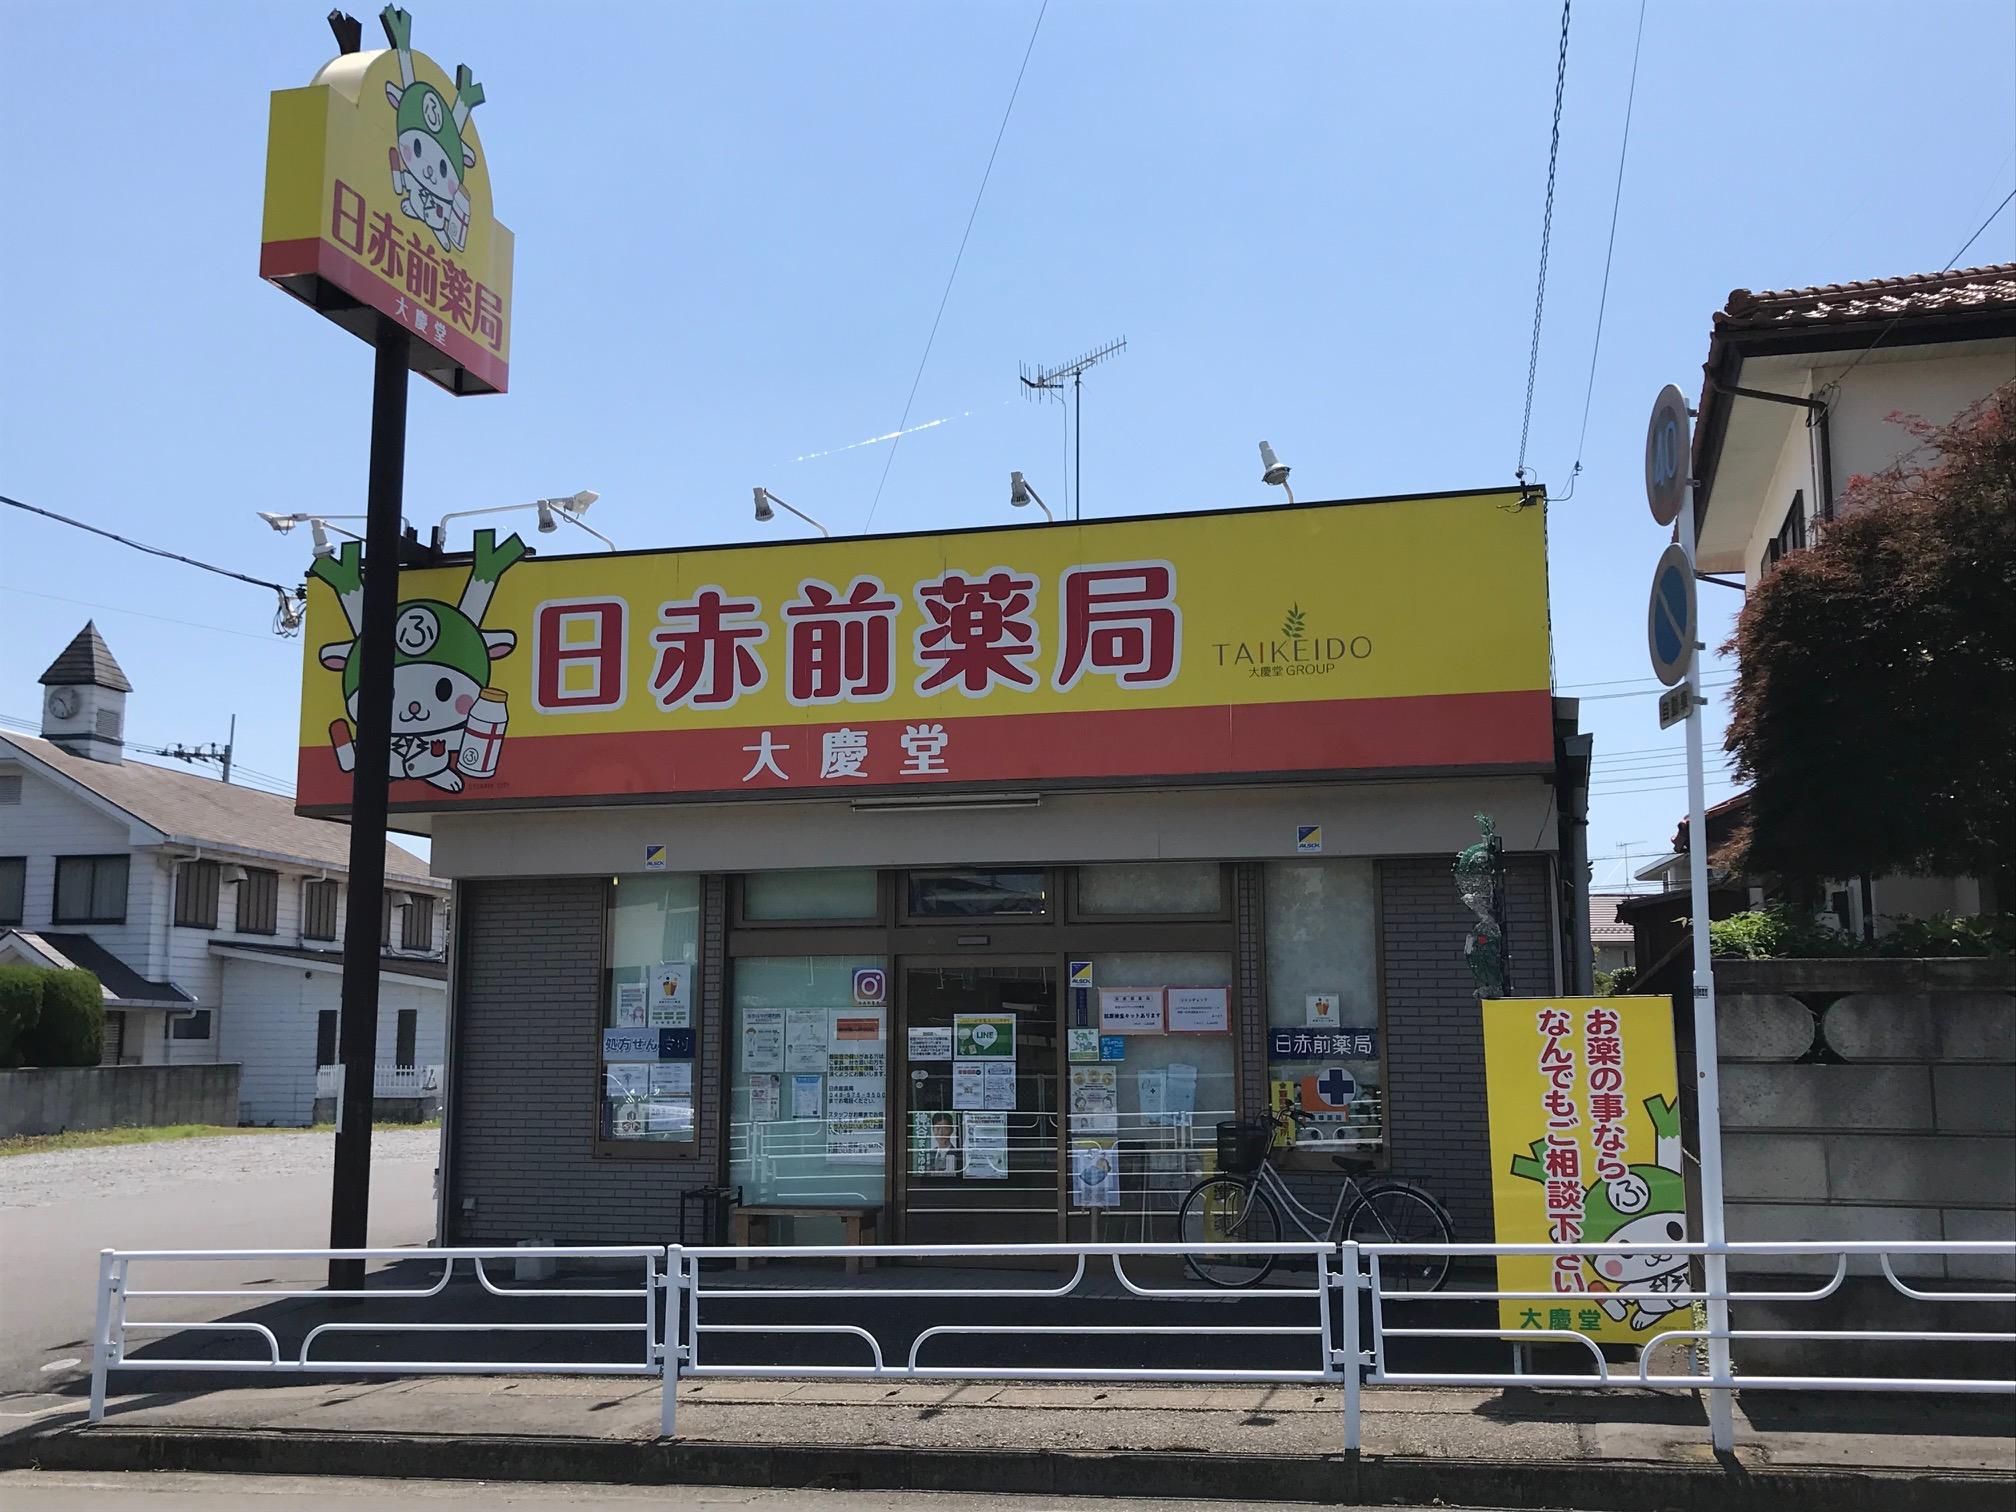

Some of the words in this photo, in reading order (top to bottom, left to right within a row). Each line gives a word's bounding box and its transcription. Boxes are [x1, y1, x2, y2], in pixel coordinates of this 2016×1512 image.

[331, 179, 503, 352] 日赤前薬局
[394, 297, 447, 346] 大慶堂
[400, 615, 435, 648] ふ
[534, 563, 1180, 712] 日赤前薬局
[1211, 635, 1372, 666] TAIKEIDO
[1249, 664, 1284, 679] 大慶堂
[1285, 662, 1335, 676] GROUP
[742, 723, 949, 783] 大慶堂
[976, 1031, 994, 1039] LINE
[1276, 1033, 1372, 1056] 日赤前薬局
[1585, 1008, 1627, 1181] お薬の事なら
[1538, 1008, 1584, 1293] なんでもご相談下さい
[1614, 1179, 1648, 1208] ふ
[1518, 1307, 1602, 1332] 大慶堂
